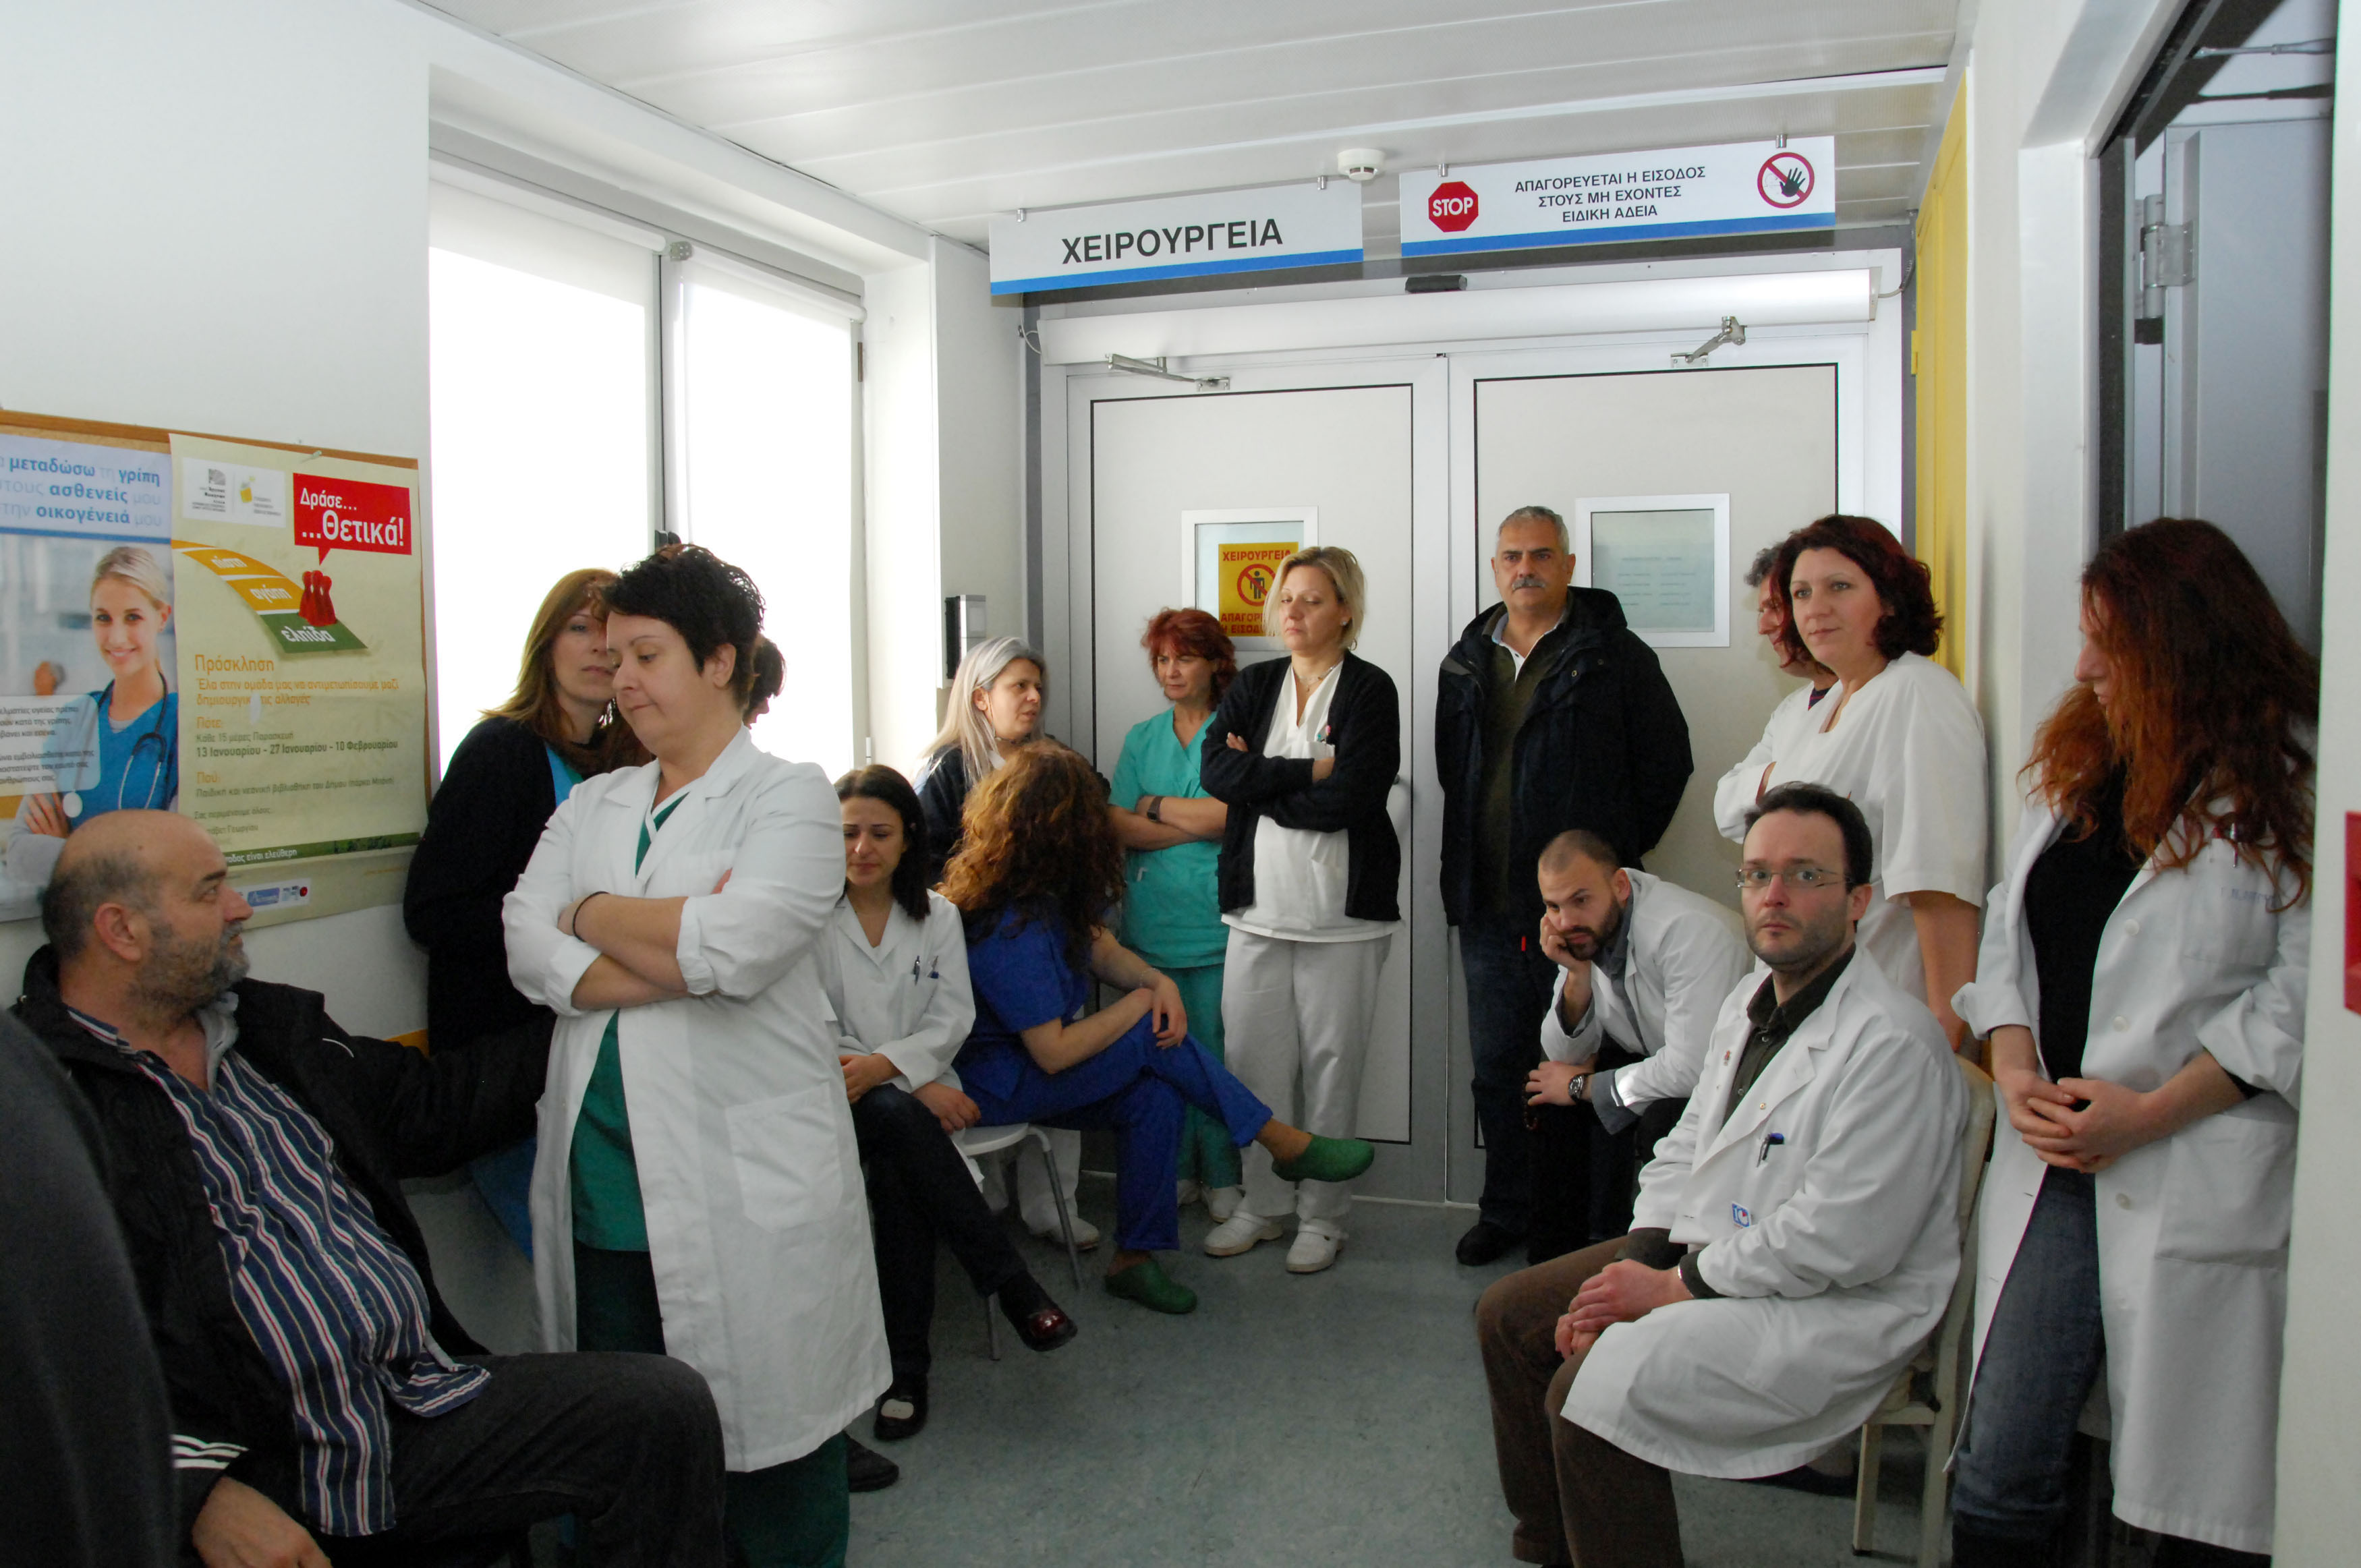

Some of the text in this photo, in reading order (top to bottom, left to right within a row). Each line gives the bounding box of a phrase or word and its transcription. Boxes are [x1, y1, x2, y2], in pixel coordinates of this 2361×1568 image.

[1515, 166, 1707, 193] ΑΠΑΓΟΡΕΥΕΤΑΙ Η ΕΙΣΟΔΟΣ
[1432, 197, 1474, 218] STOP
[1539, 185, 1682, 208] ΣΤΟΥΣ ΜΗ ΕΧΟΝΤΕΣ
[1562, 205, 1657, 223] ΕΙΔΙΚΗ ΑΔΕΙΑ
[1062, 219, 1283, 264] ΧΕΙΡΟΥΡΓΕΙΑ
[9, 457, 95, 476] μεταδώσω
[119, 468, 160, 487] γρίπη
[49, 483, 128, 504] ασθενείς
[133, 493, 161, 506] μου
[300, 488, 357, 510] Δράσε...
[36, 506, 130, 524] οικογένειά
[135, 515, 162, 528] μου
[302, 510, 404, 546] ...Θετικά!
[1221, 613, 1263, 622] ΑΠΑΓΟΡ
[281, 626, 336, 642] ελπίδα
[195, 654, 275, 675] Πρόσκληση
[197, 747, 207, 757] 13
[210, 745, 261, 758] Ιανουαρίου
[270, 745, 280, 755] 27
[282, 742, 327, 755] Ιανουαρίου
[336, 741, 345, 751] 10
[347, 739, 398, 753] Φεβρουαρίου
